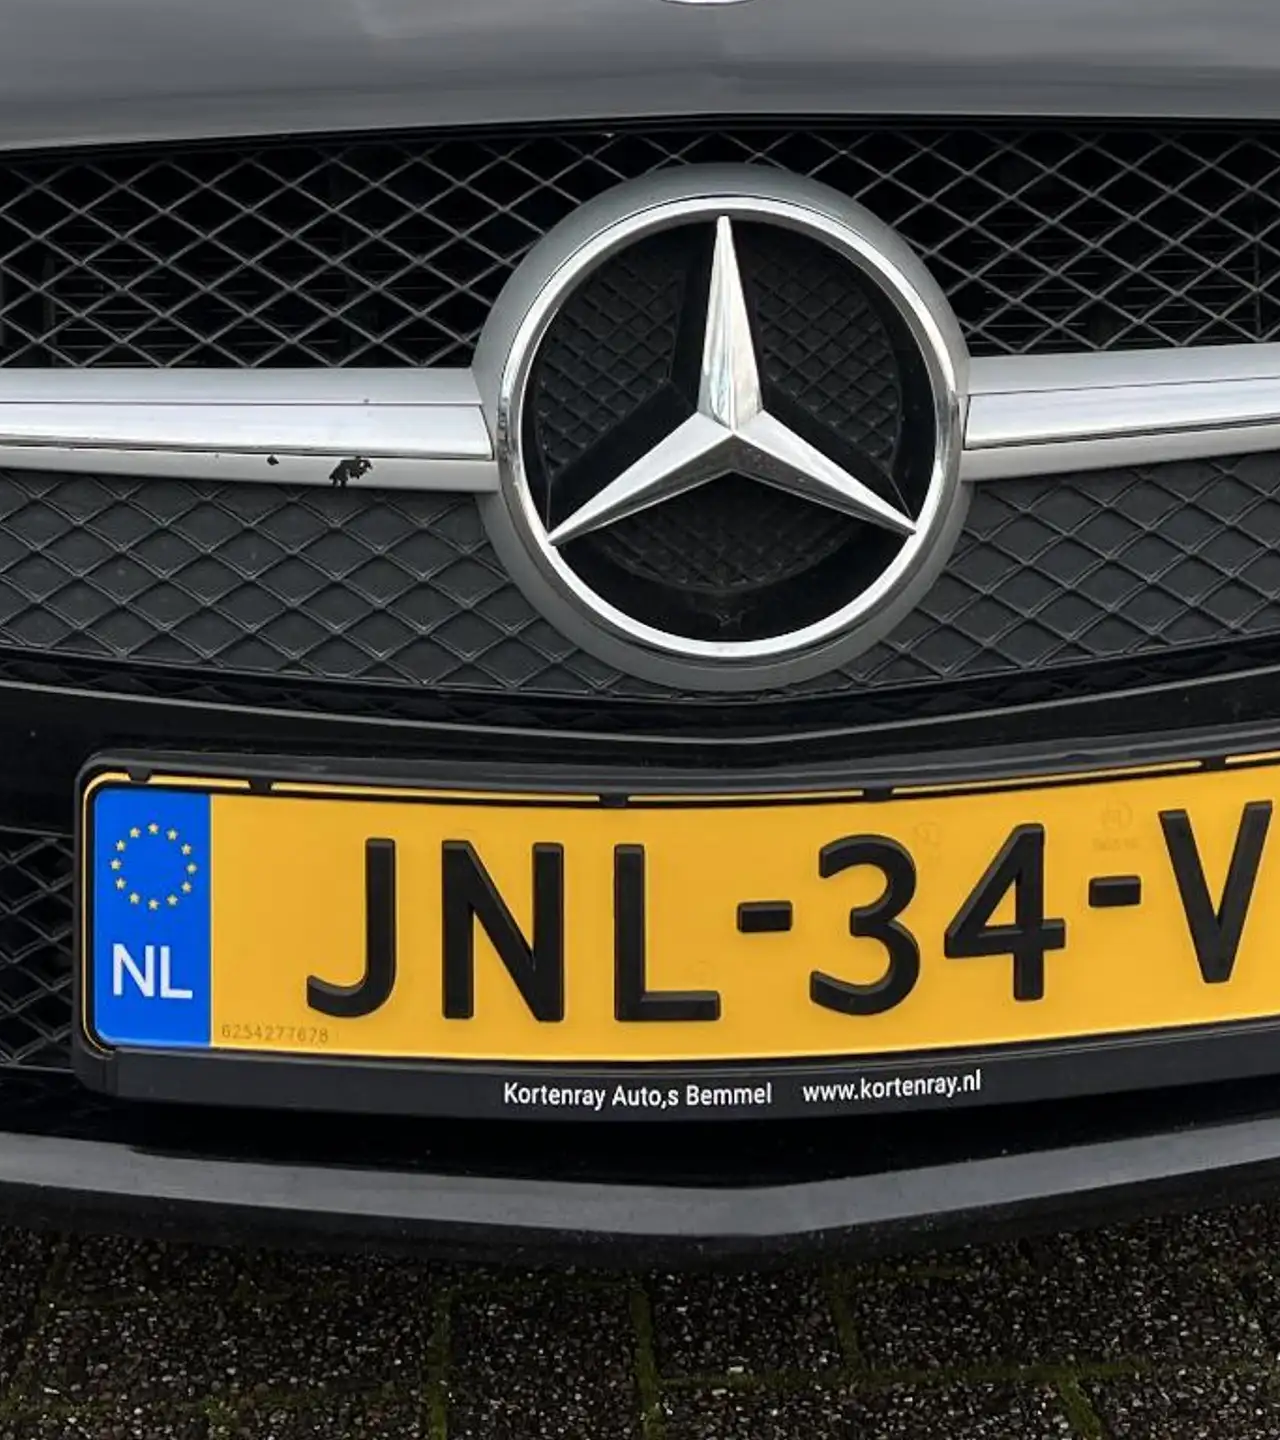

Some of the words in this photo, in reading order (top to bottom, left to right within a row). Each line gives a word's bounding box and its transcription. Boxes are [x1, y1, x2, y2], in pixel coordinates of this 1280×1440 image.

[306, 800, 1273, 1023] JNL-34-V
[113, 943, 193, 999] NL
[504, 1082, 606, 1112] Kortenray
[611, 1085, 679, 1110] Auto,s
[686, 1082, 772, 1106] Bemmel
[802, 1068, 981, 1102] www.kortenray.nl
